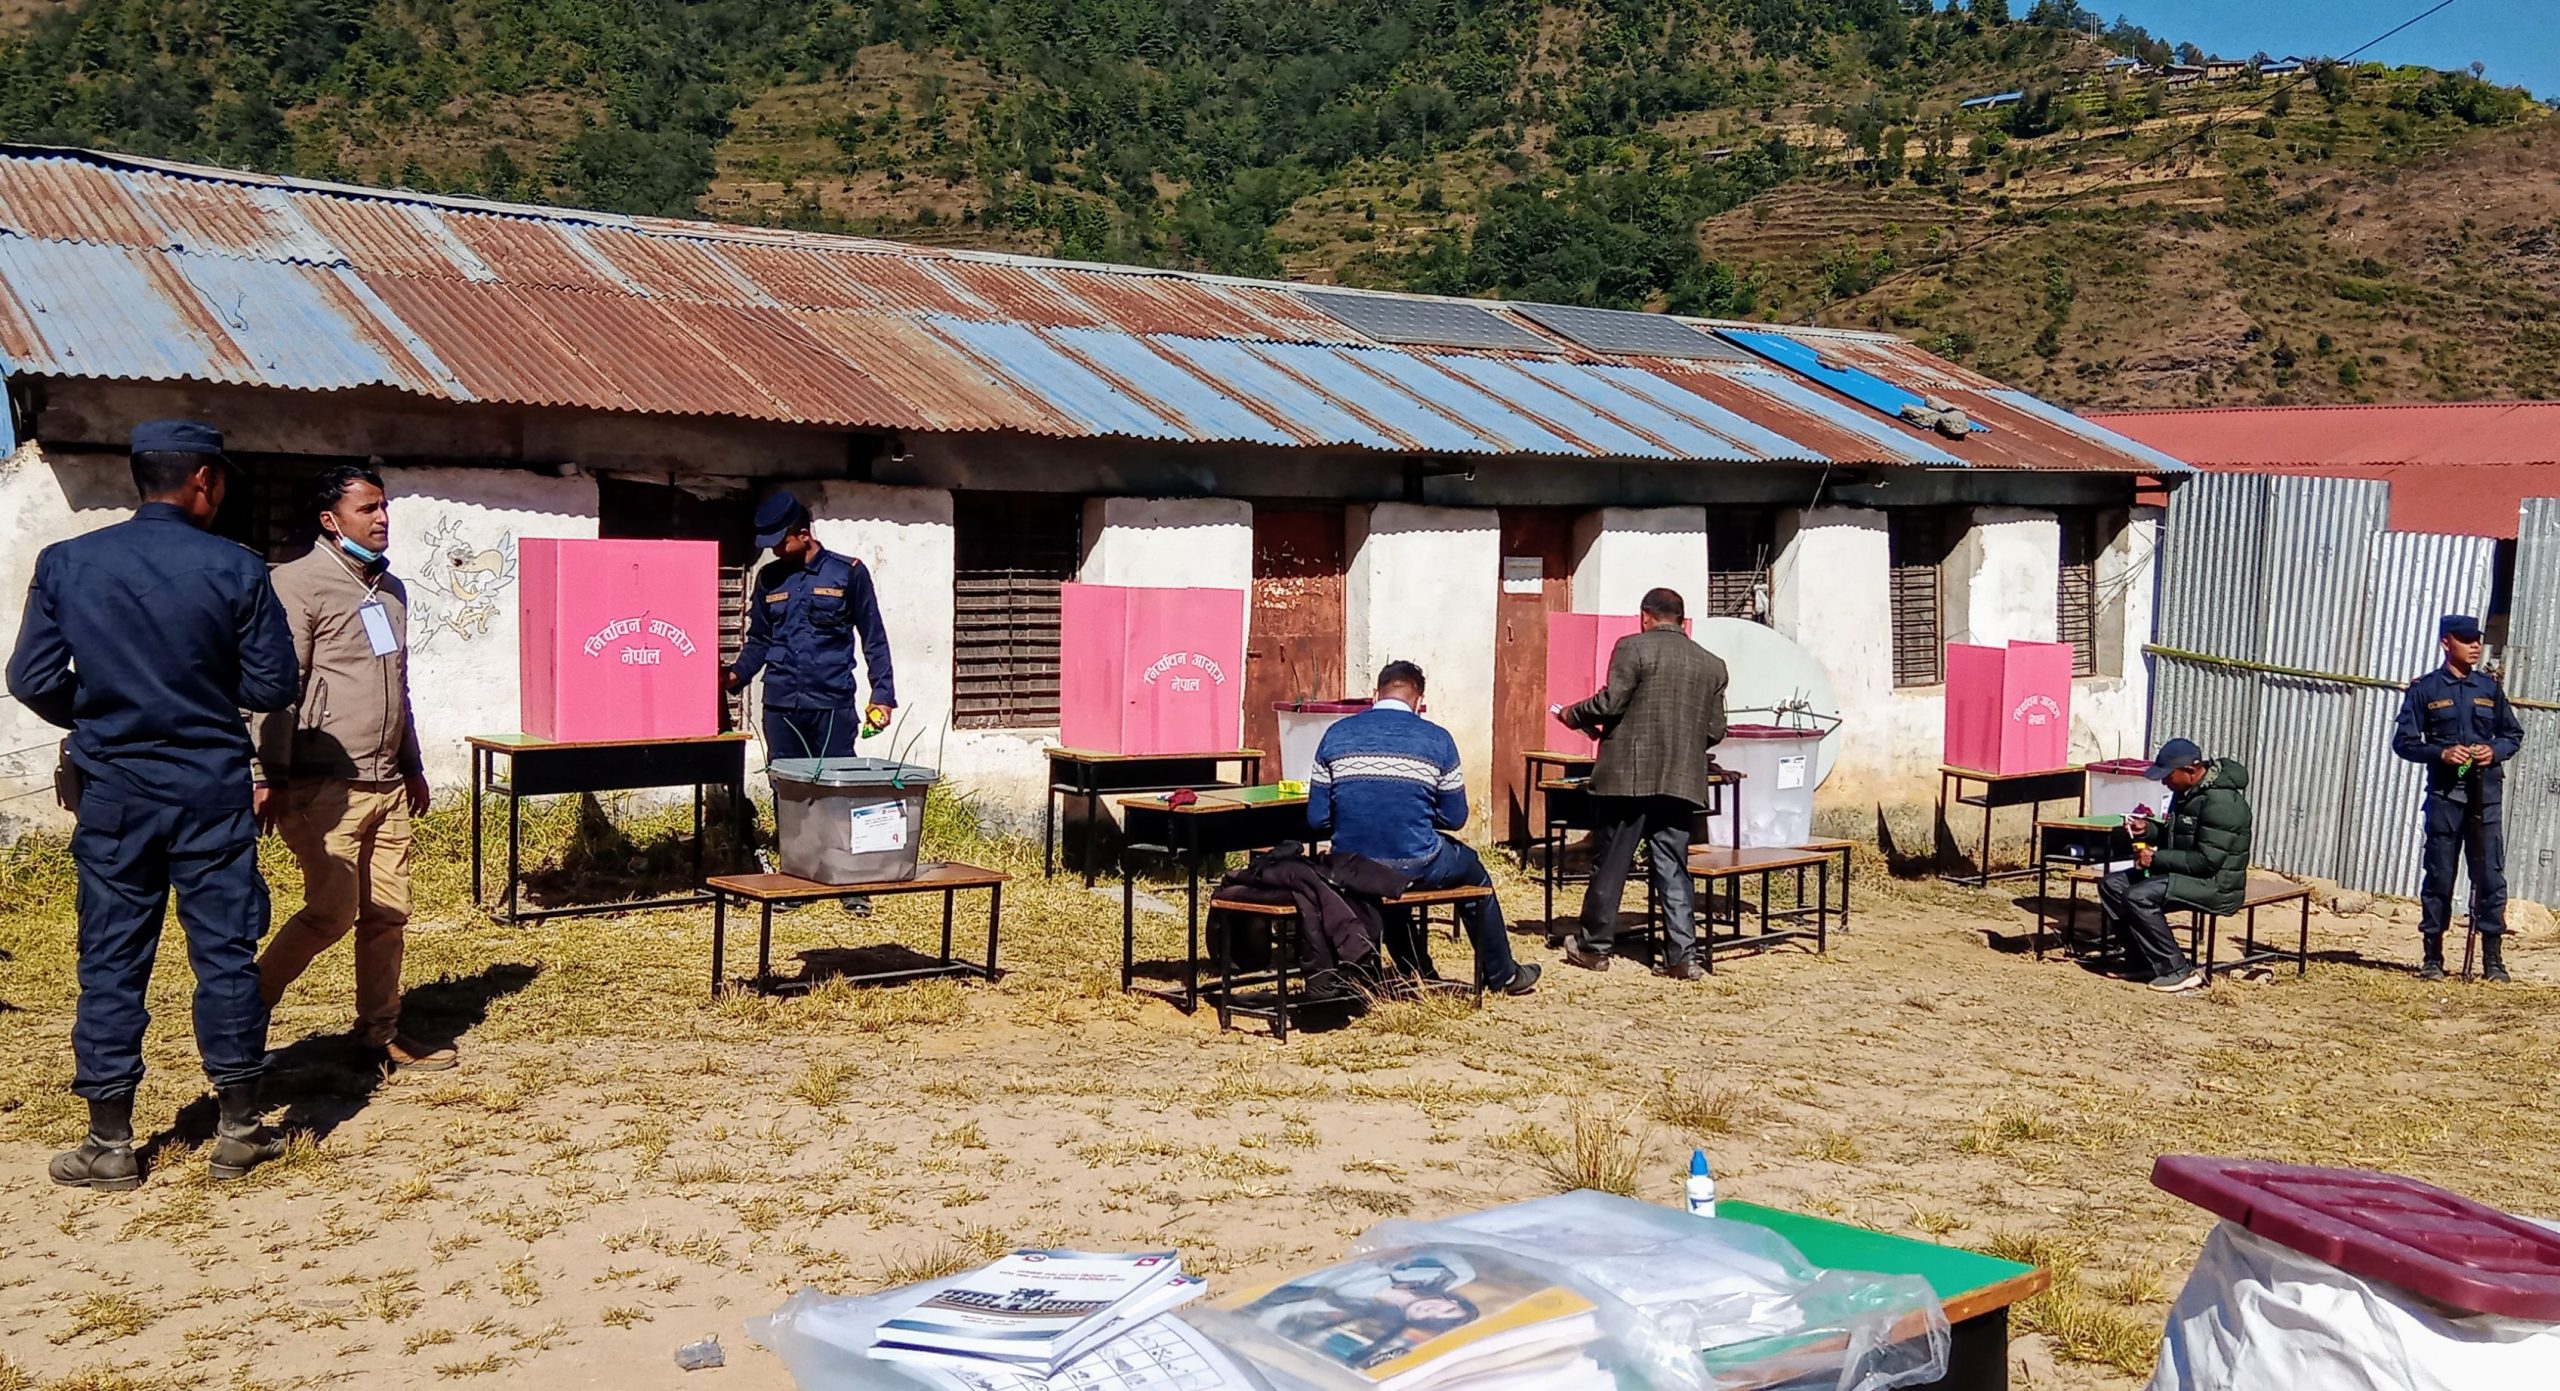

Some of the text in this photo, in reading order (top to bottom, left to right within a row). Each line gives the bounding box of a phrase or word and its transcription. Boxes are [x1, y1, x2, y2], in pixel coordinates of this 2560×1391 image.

[583, 618, 697, 657] निर्वाचन आयोग
[620, 646, 661, 664] नेपाल
[1143, 652, 1226, 685] निर्वाचन आयोग
[1170, 675, 1200, 691] नेपाल
